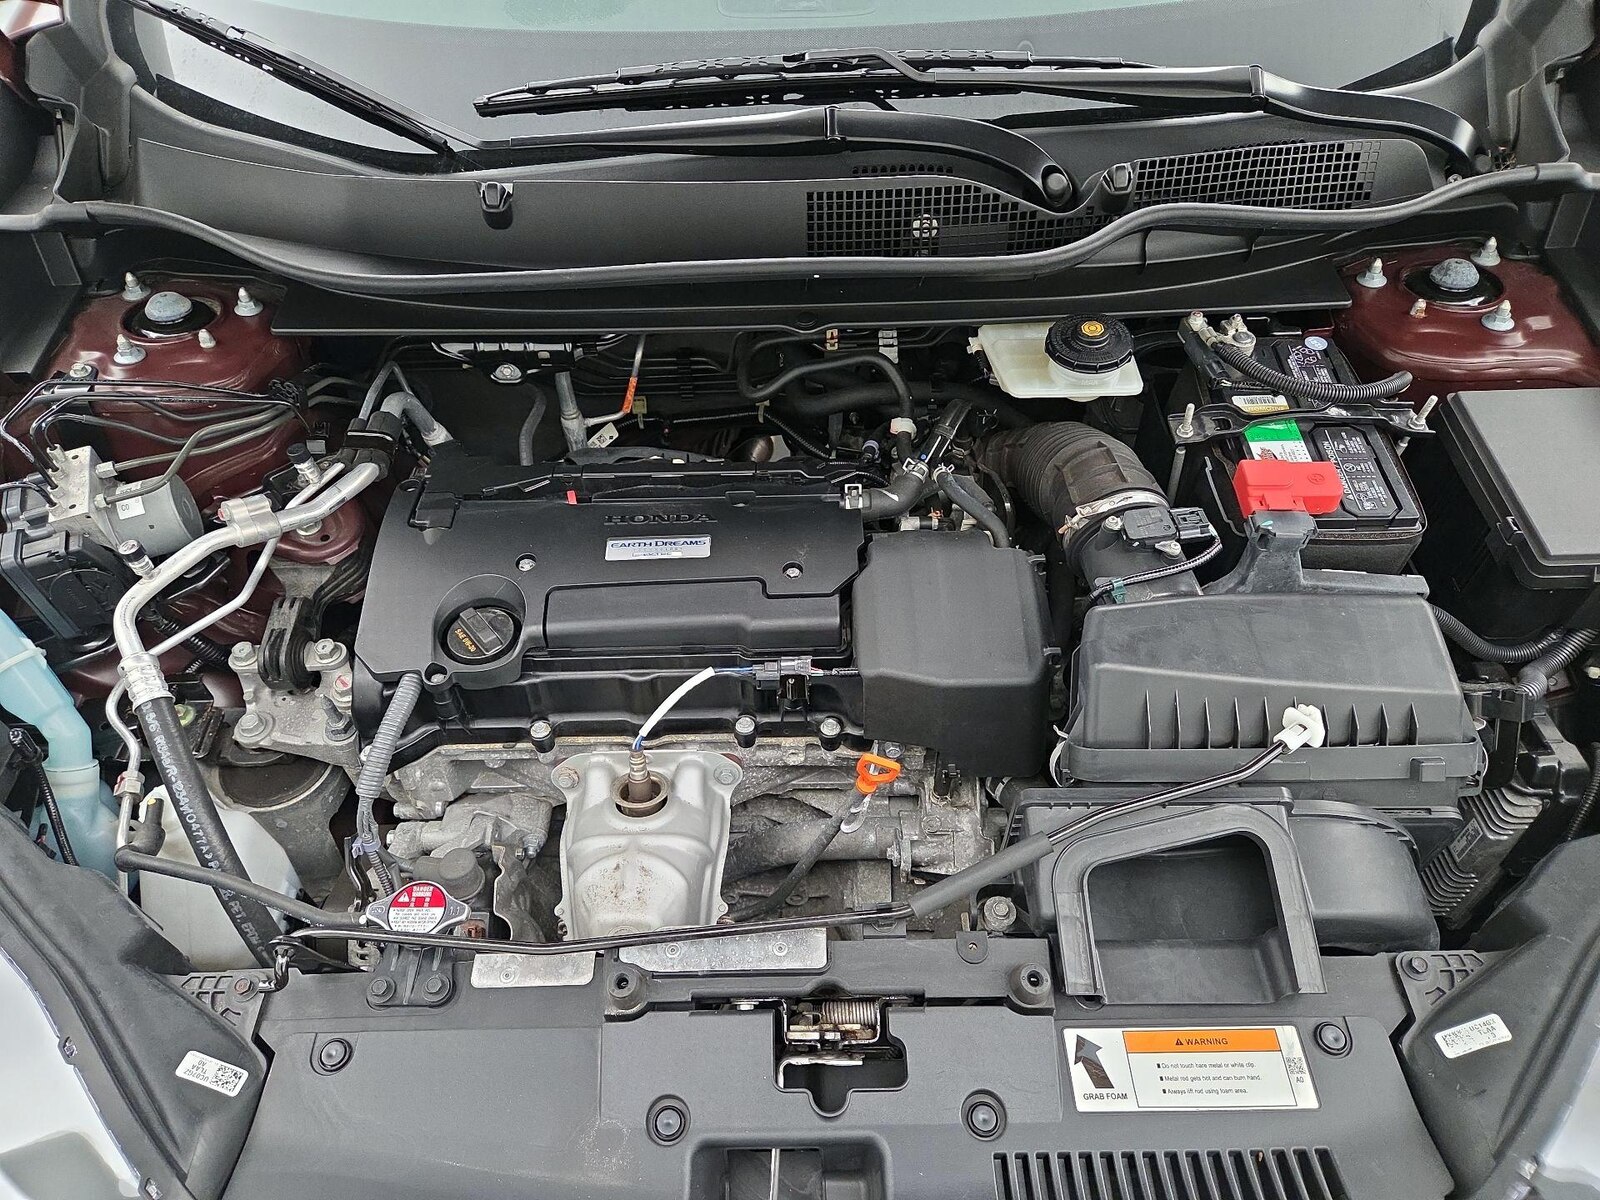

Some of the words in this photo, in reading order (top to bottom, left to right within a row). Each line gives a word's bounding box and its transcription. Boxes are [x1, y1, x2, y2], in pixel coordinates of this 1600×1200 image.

[603, 513, 718, 525] HONDA
[454, 629, 466, 639] SAE
[1185, 1038, 1229, 1046] WARNING
[1083, 1092, 1105, 1100] GRAB
[1106, 1092, 1128, 1100] FOAM
